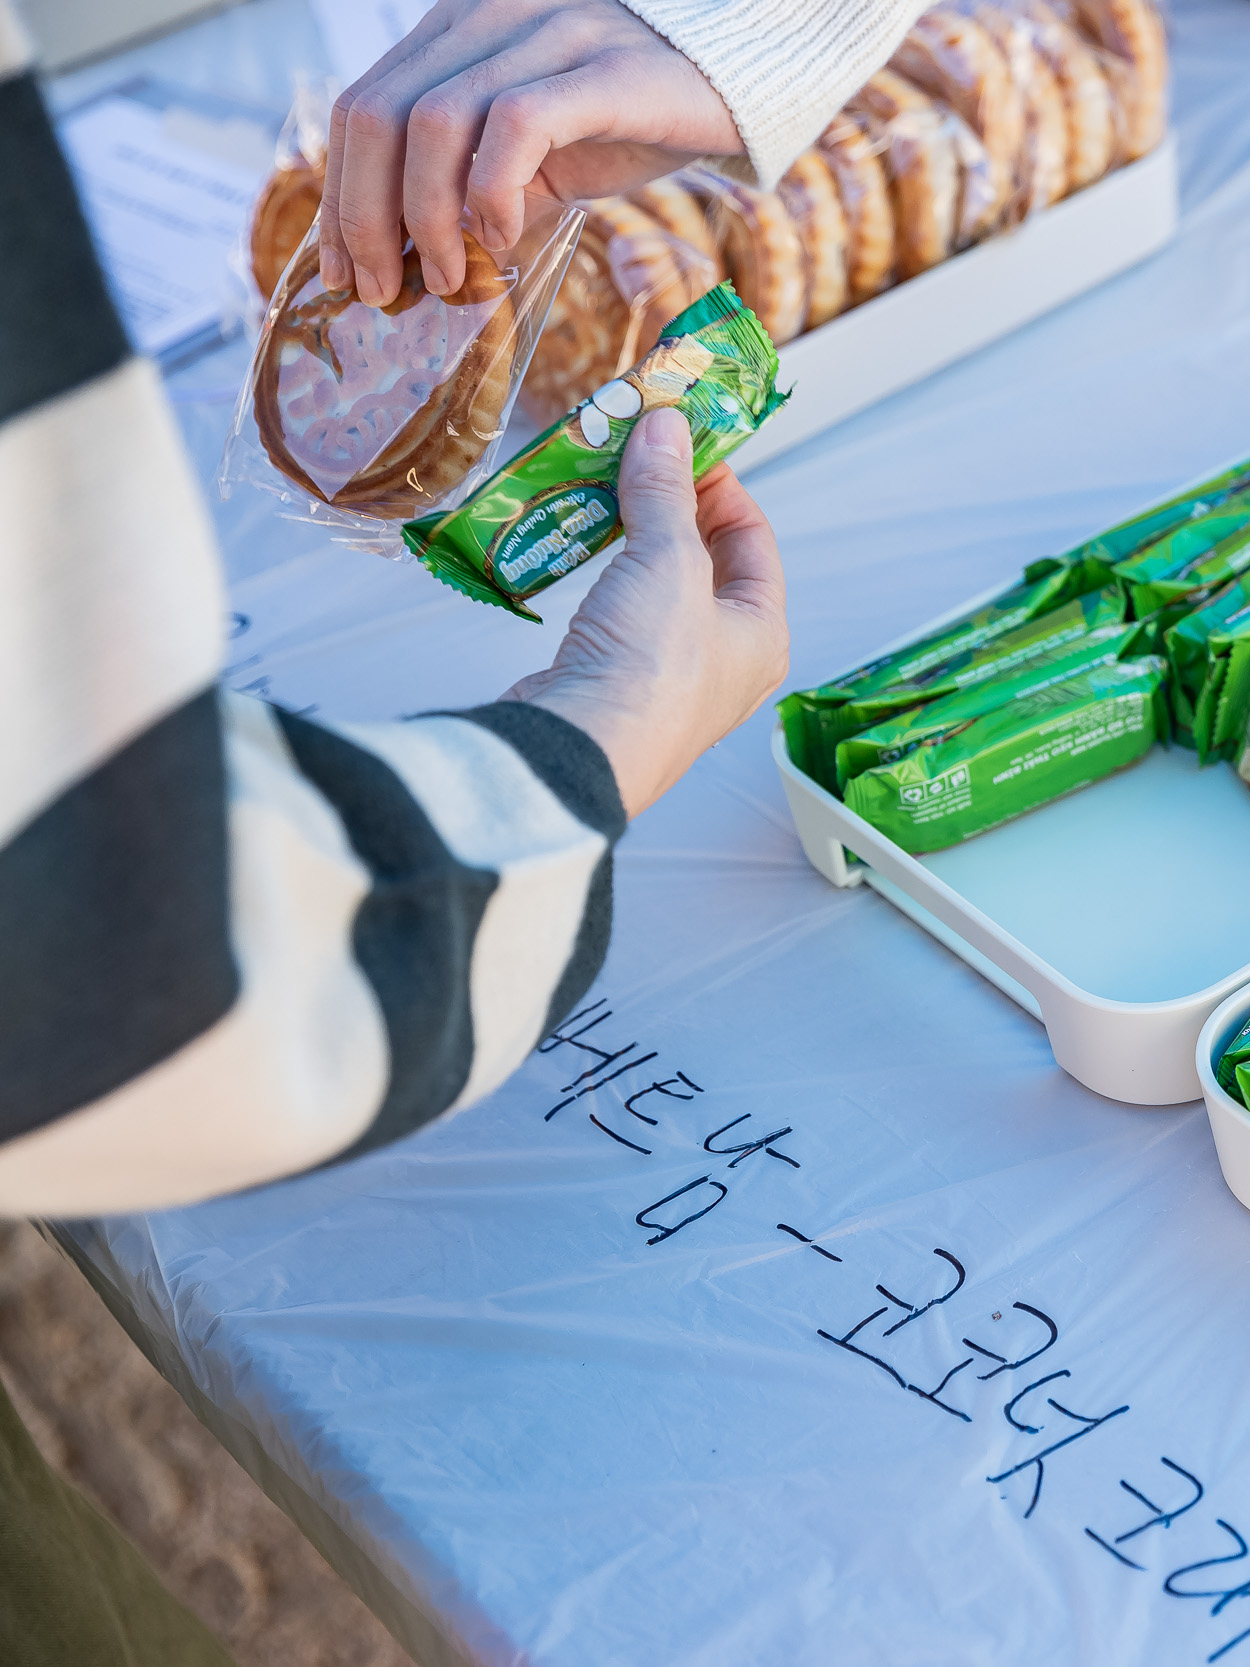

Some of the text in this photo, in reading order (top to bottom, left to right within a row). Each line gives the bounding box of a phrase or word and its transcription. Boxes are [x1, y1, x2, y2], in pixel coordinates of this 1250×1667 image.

[499, 500, 609, 582] Dừa Nướng
[502, 533, 522, 559] Nam
[547, 542, 591, 576] Bánh
[816, 1248, 1129, 1518] 코코넛
